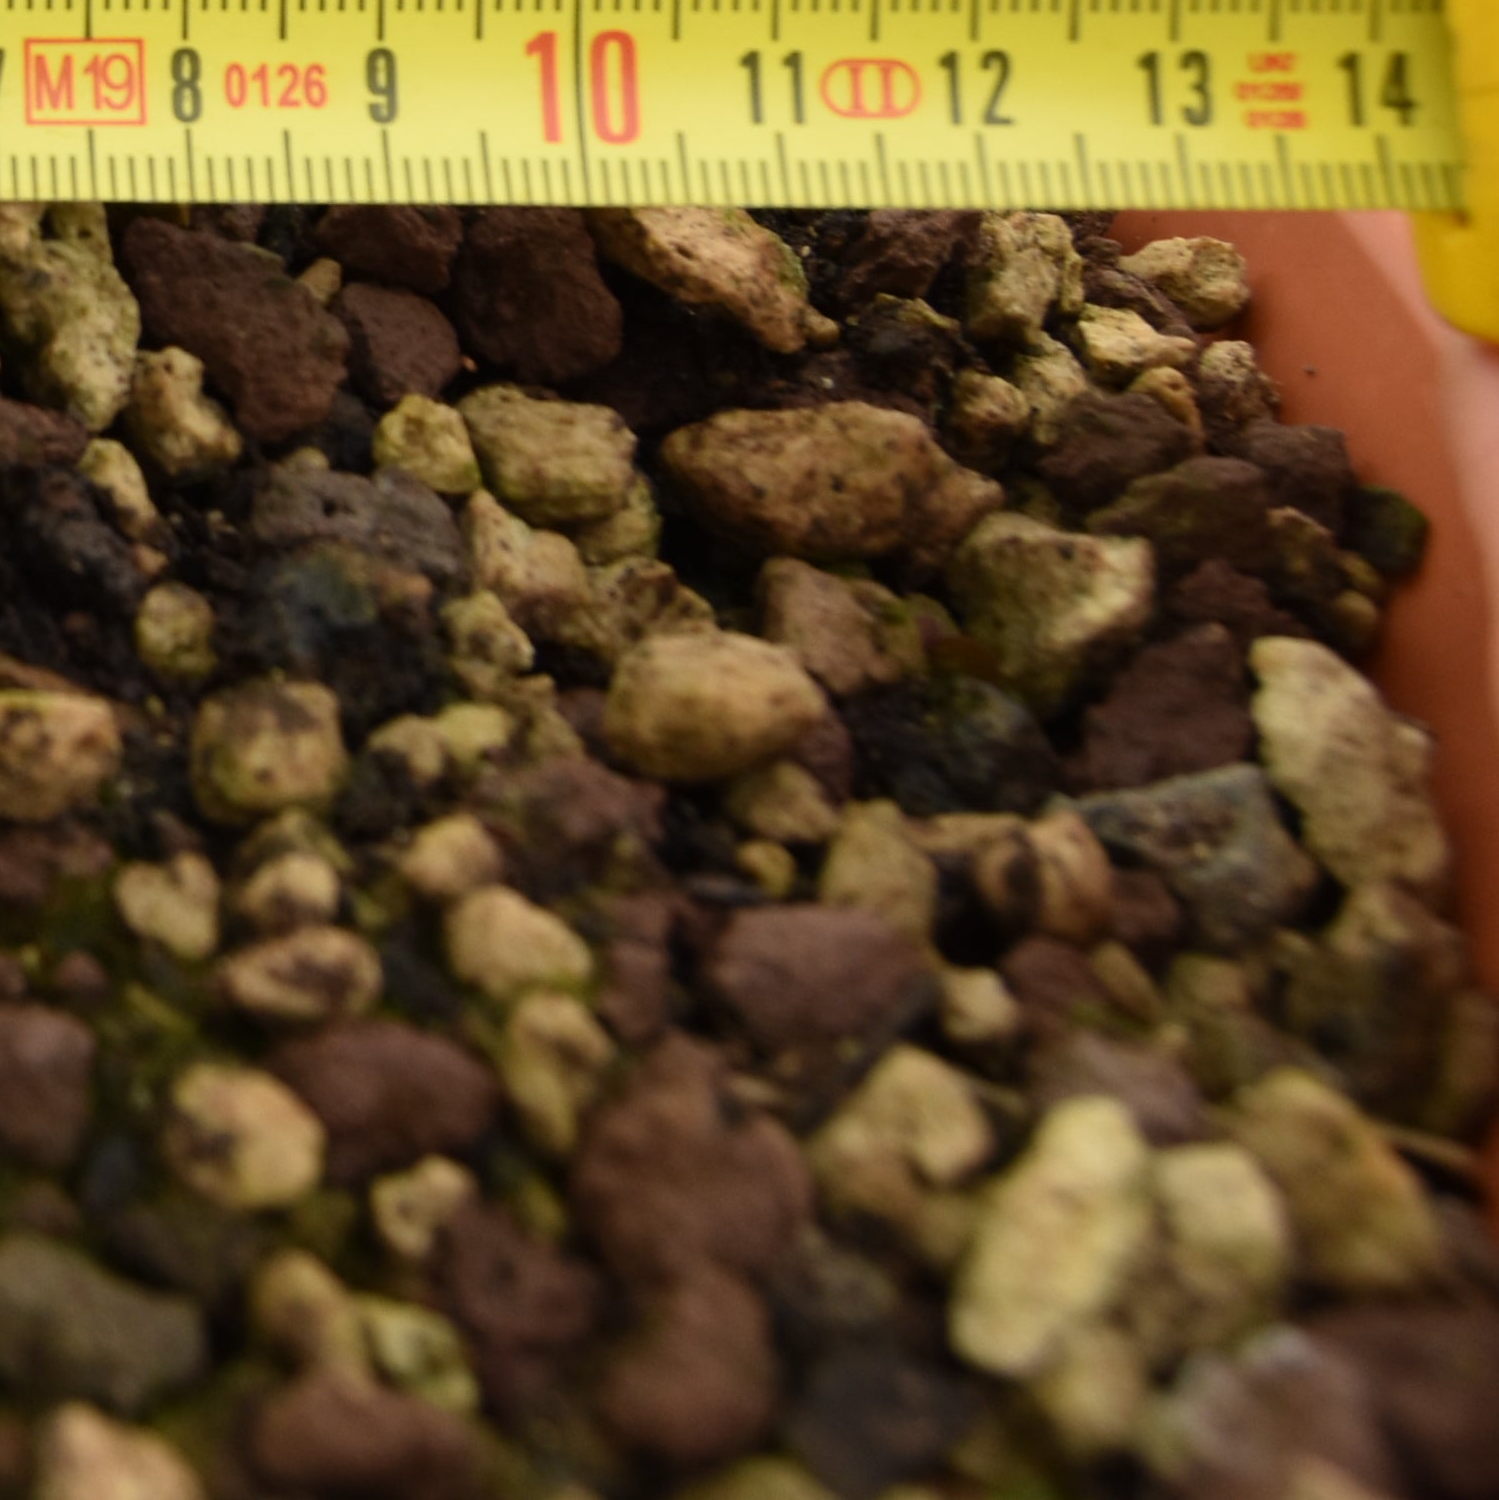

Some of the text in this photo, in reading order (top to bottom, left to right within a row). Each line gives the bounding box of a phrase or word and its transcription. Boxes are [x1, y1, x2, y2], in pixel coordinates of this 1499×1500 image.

[171, 47, 203, 123] 8
[224, 62, 329, 109] 0126
[366, 47, 399, 123] 9
[525, 30, 641, 144] 10
[739, 50, 806, 125] 11
[938, 50, 1014, 126] 12
[1135, 50, 1213, 127] 13
[1335, 51, 1417, 128] 14
